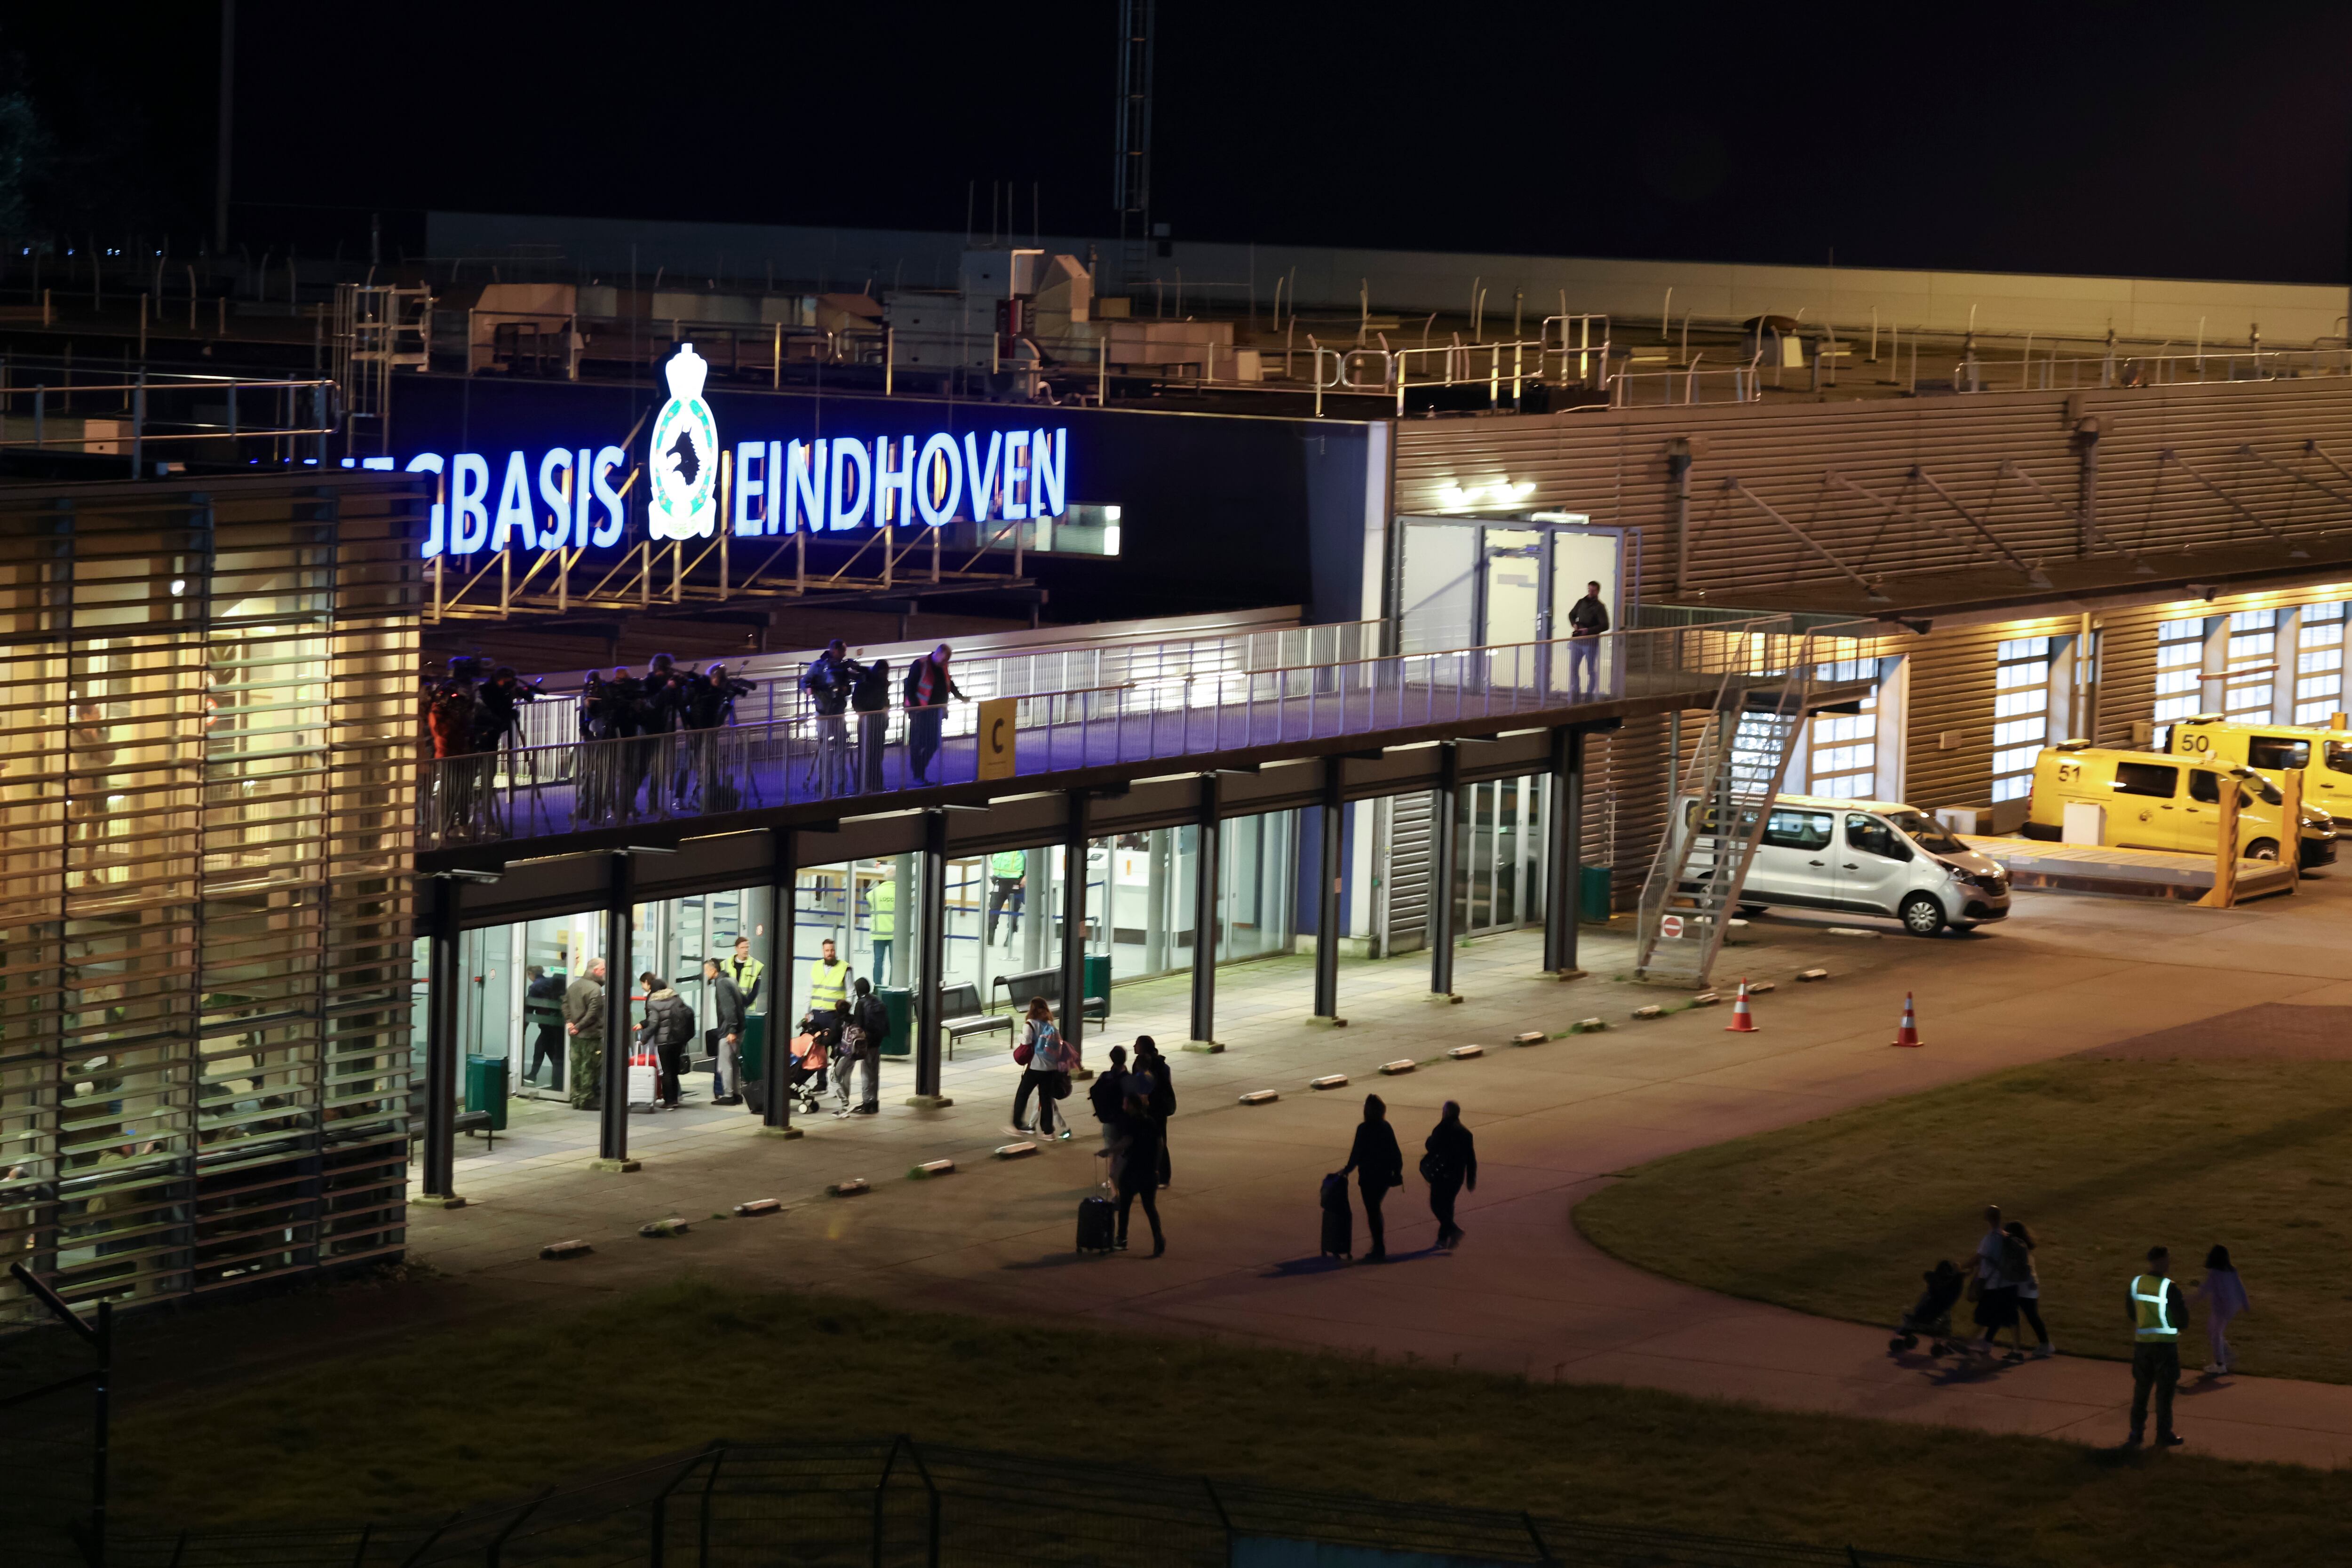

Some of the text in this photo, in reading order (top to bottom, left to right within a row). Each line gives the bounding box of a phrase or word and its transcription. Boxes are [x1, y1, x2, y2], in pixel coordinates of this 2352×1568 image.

[735, 427, 1066, 537] EINDHOVEN
[2182, 734, 2209, 753] 50
[2058, 765, 2080, 782] 51
